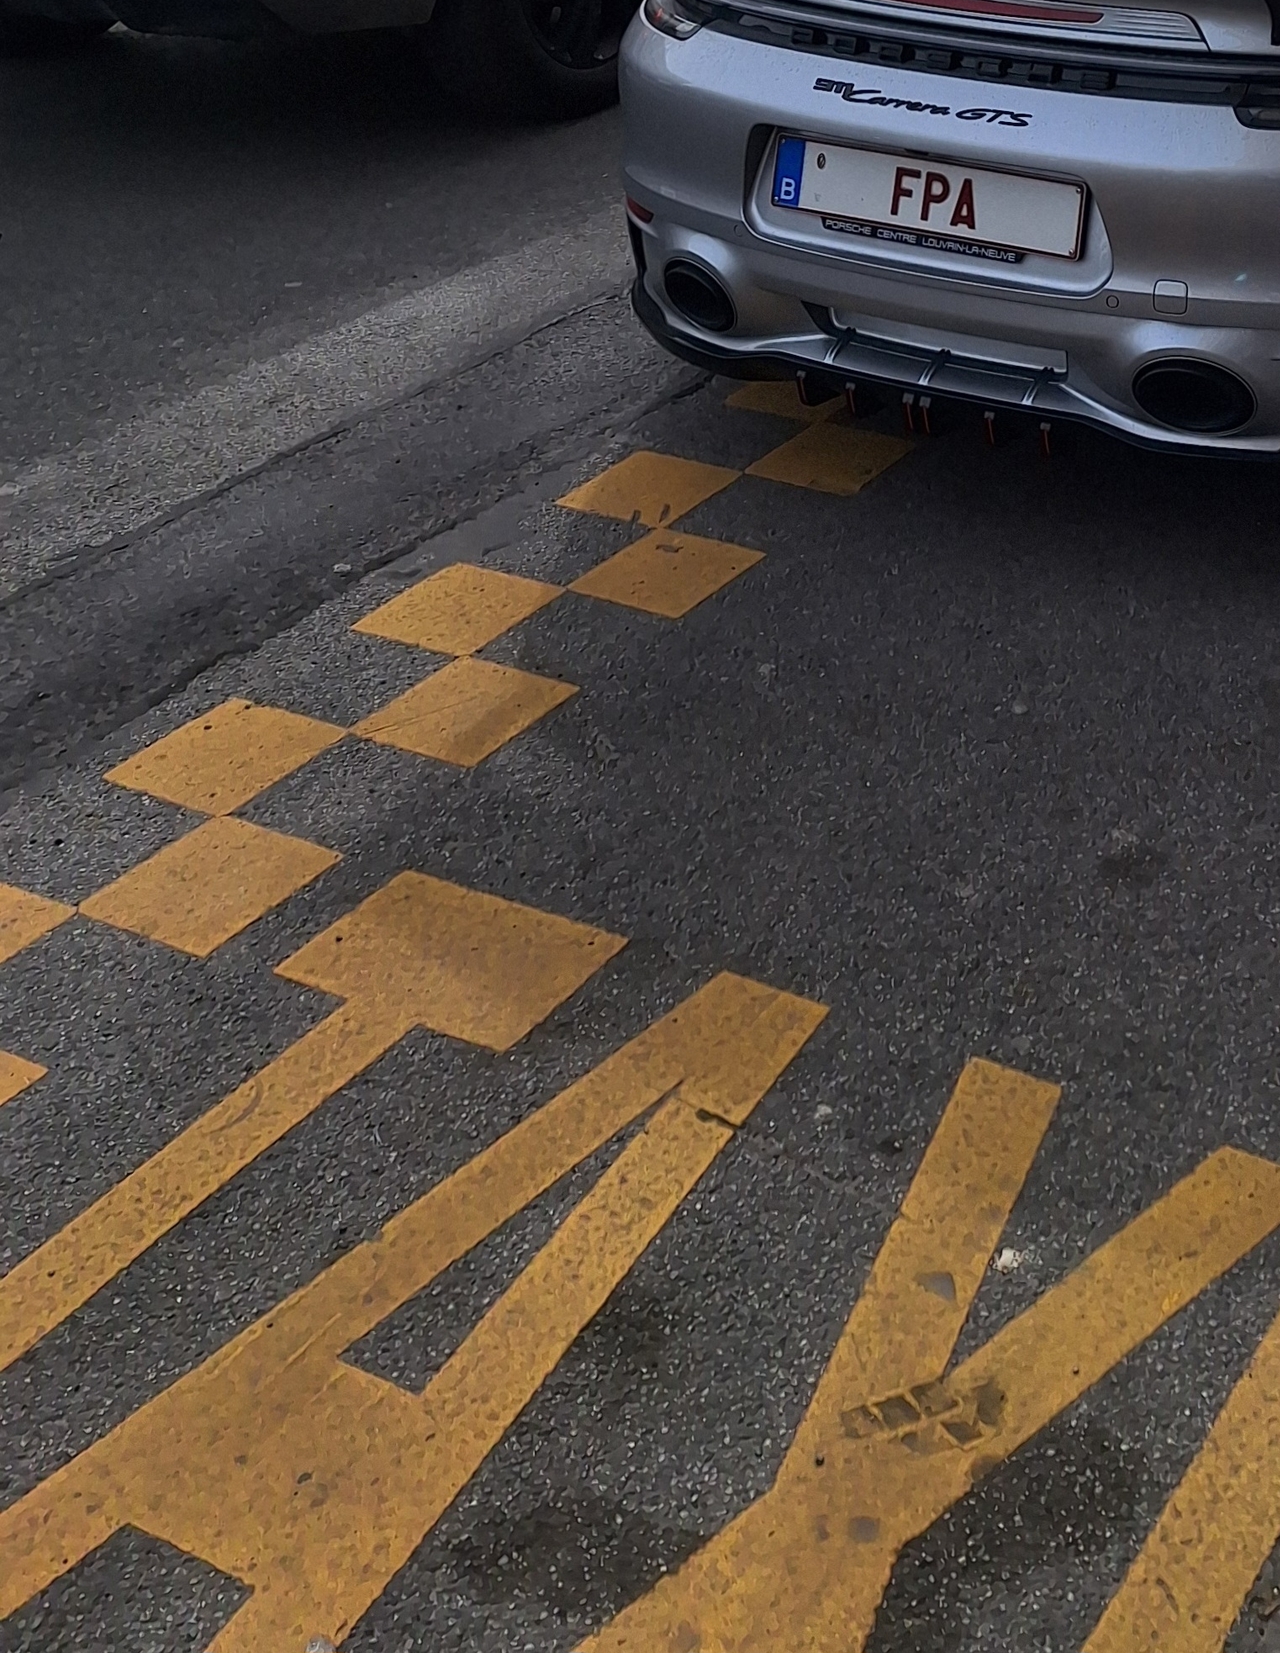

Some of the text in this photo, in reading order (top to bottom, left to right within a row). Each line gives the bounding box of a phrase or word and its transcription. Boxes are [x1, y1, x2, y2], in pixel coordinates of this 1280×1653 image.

[842, 89, 951, 116] Carrera
[955, 108, 1033, 127] GTS
[779, 177, 797, 201] B
[889, 165, 976, 231] FPA
[825, 219, 1016, 262] PORSCHE CENTRE LOUVAIN-LA-NEUVE
